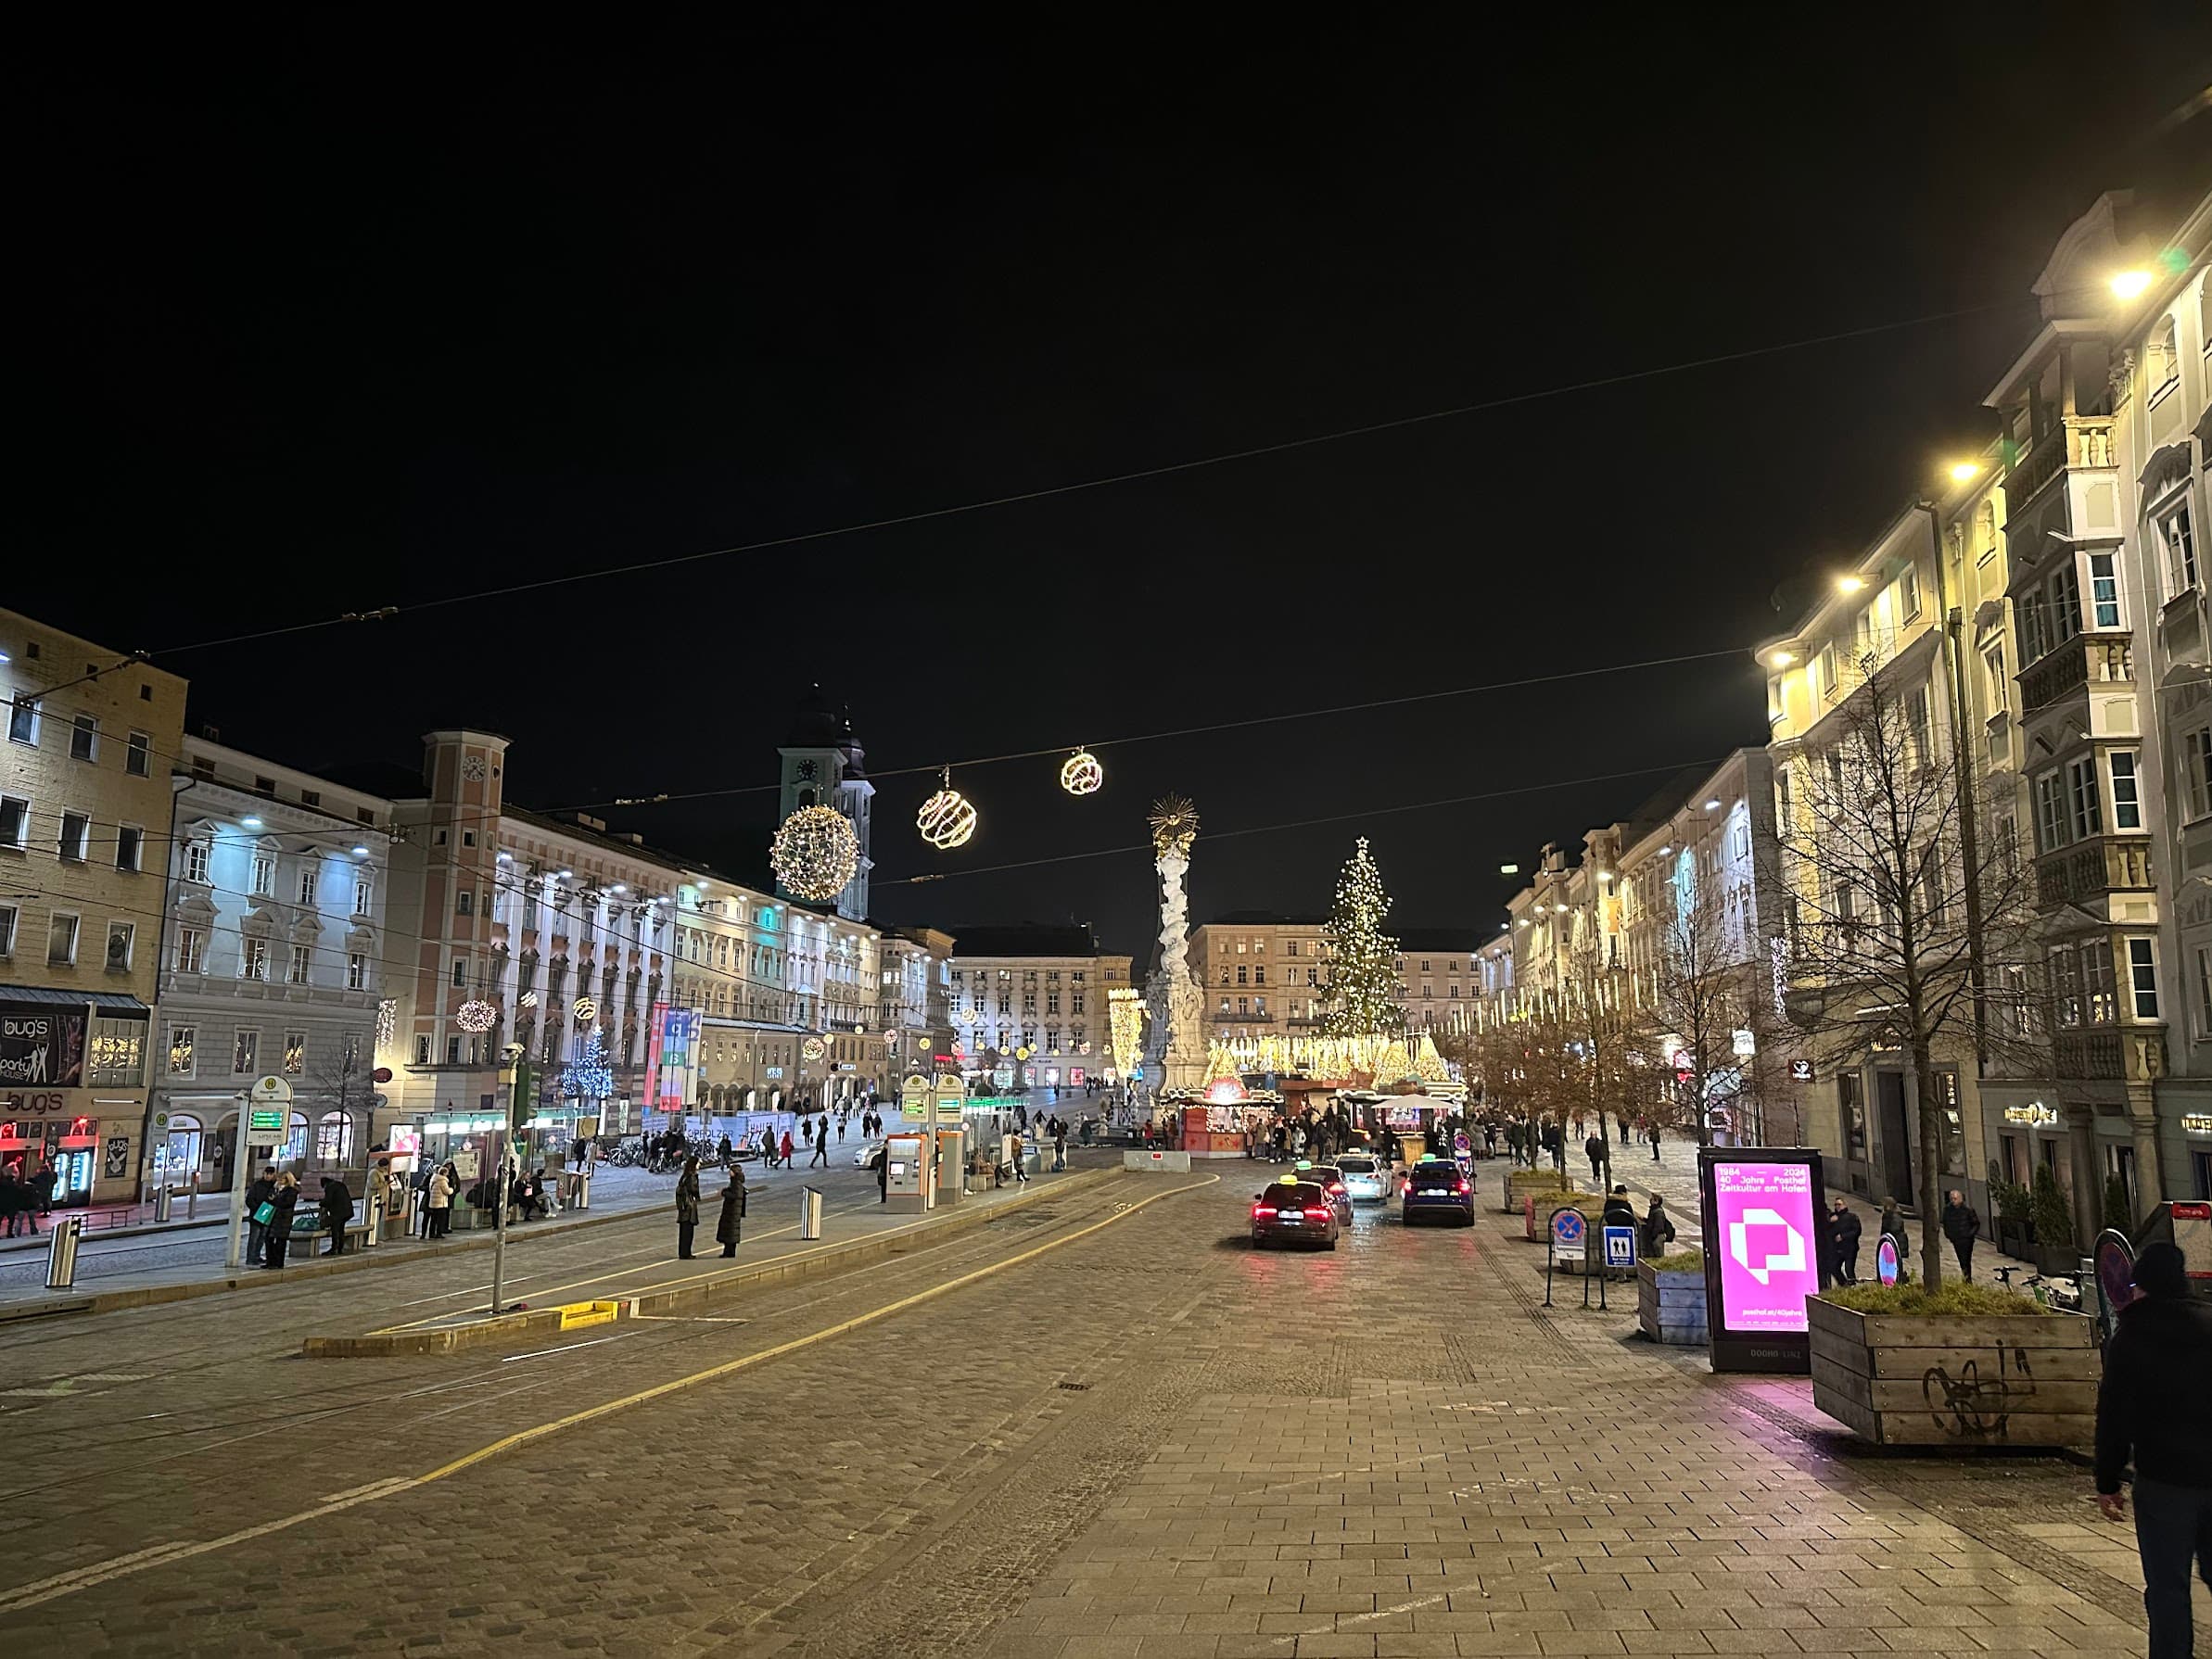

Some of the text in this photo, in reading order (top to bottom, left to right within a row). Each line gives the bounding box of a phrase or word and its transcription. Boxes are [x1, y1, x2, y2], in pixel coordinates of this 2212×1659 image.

[4, 1019, 48, 1037] bug's
[0, 1057, 32, 1076] party
[6, 1092, 63, 1115] bug's
[1719, 1168, 1740, 1176] 1984
[1784, 1168, 1806, 1176] 2024
[1720, 1176, 1806, 1184] 40 Jahre Posthof
[1720, 1184, 1761, 1193] Zeitkultur
